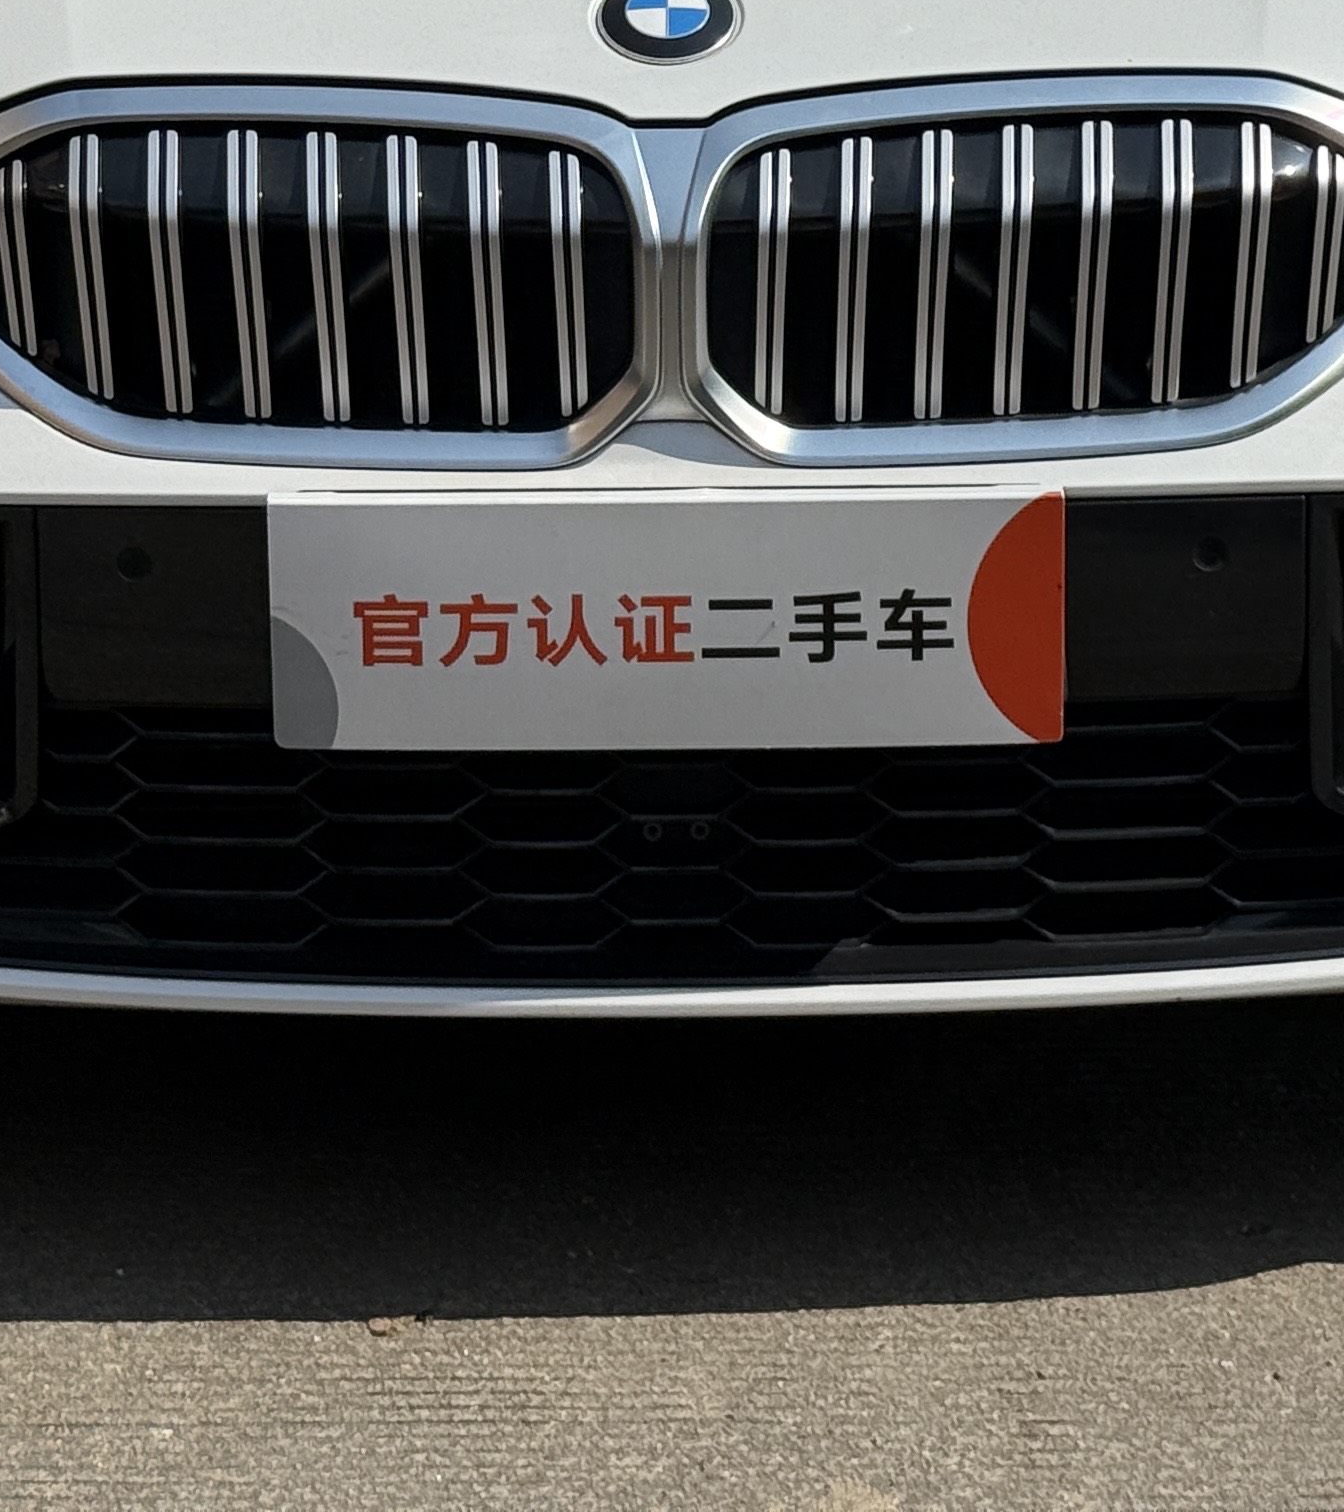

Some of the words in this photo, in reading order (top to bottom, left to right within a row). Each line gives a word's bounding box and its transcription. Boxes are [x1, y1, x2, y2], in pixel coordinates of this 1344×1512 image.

[352, 589, 955, 668] 官方认证二手车
